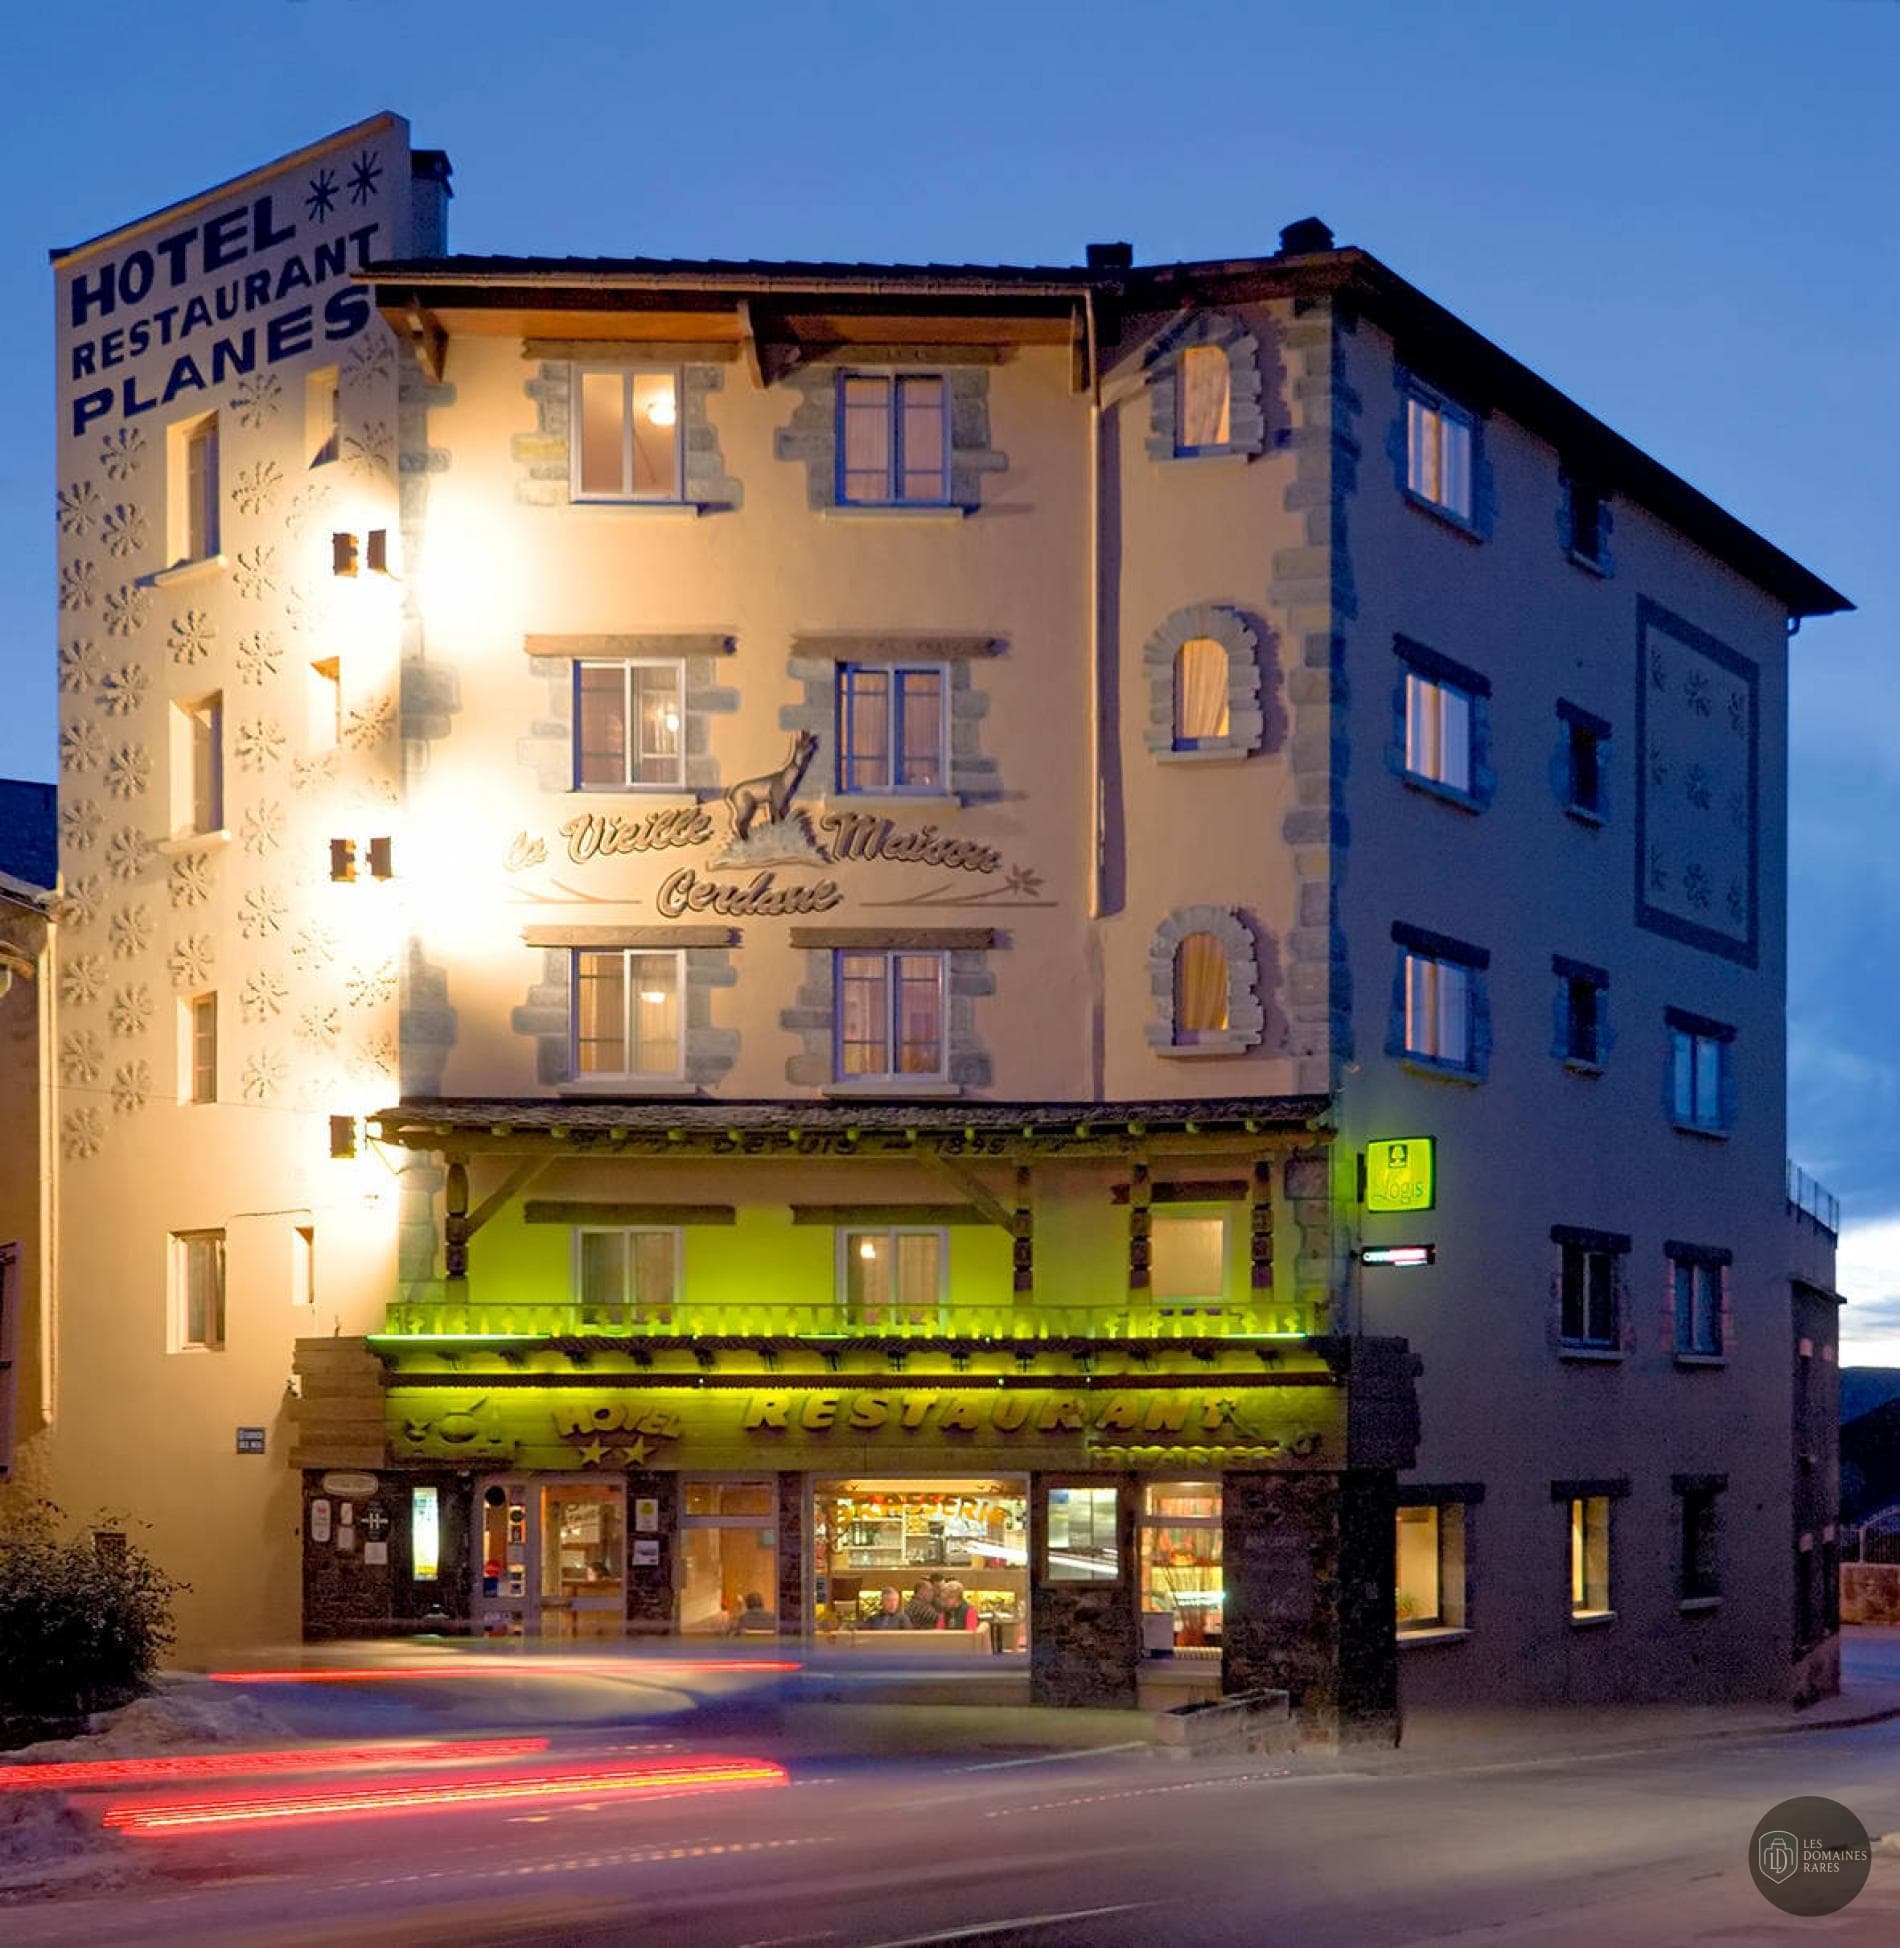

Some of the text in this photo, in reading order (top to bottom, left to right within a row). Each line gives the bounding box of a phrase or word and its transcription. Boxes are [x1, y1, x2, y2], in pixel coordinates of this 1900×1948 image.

[72, 195, 296, 328] HOTEL
[73, 223, 380, 381] RESTAURANT
[74, 285, 370, 437] PLANES
[560, 805, 714, 865] Vieille
[820, 810, 1002, 873] Maison
[656, 866, 844, 918] Cerdane
[552, 1405, 682, 1440] HOTEL
[742, 1394, 1237, 1432] RESTAURANT
